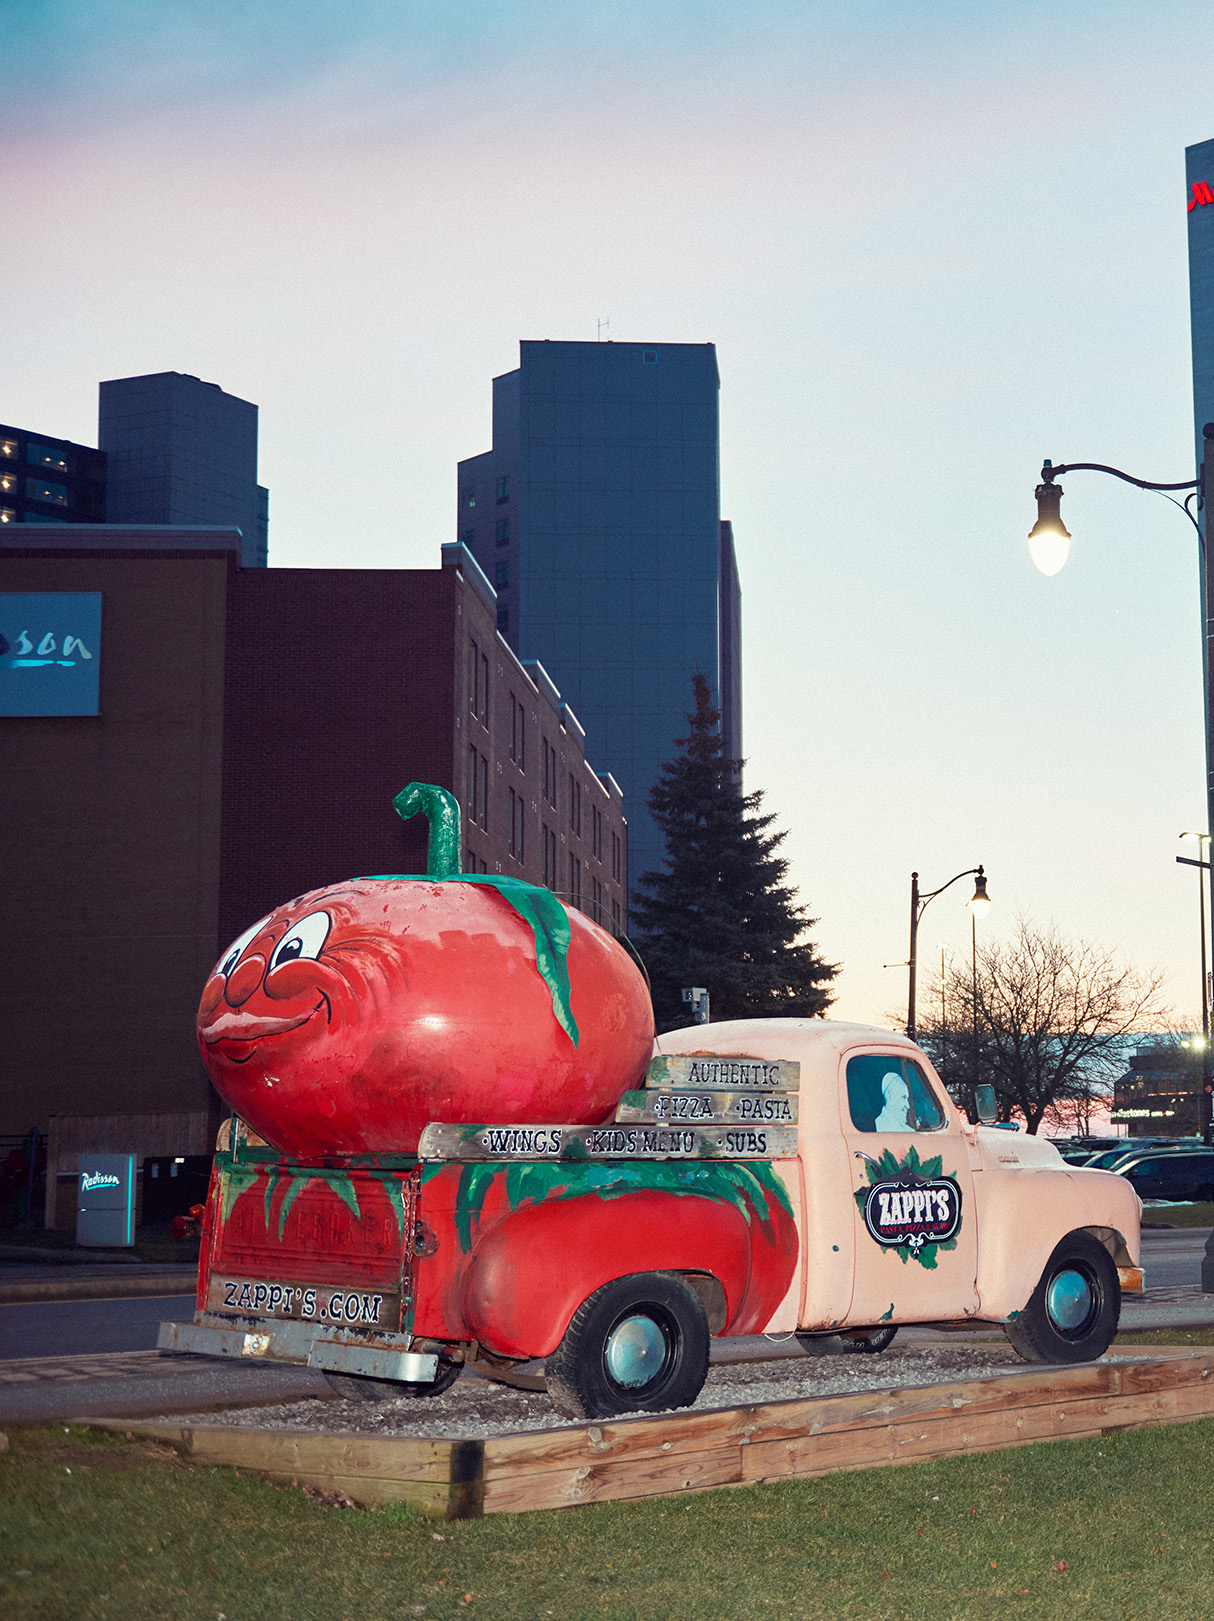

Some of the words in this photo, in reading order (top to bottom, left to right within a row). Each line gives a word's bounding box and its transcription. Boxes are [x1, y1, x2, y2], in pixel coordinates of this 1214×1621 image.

[688, 1062, 780, 1086] AUTHENTIC
[658, 1096, 714, 1120] PIZZA
[739, 1098, 793, 1120] PASTA
[487, 1129, 562, 1153] WINGS
[591, 1130, 637, 1153] KIDS
[725, 1132, 767, 1153] SUBS
[82, 1170, 120, 1192] Radisson
[879, 1189, 950, 1226] ZAPPI'S
